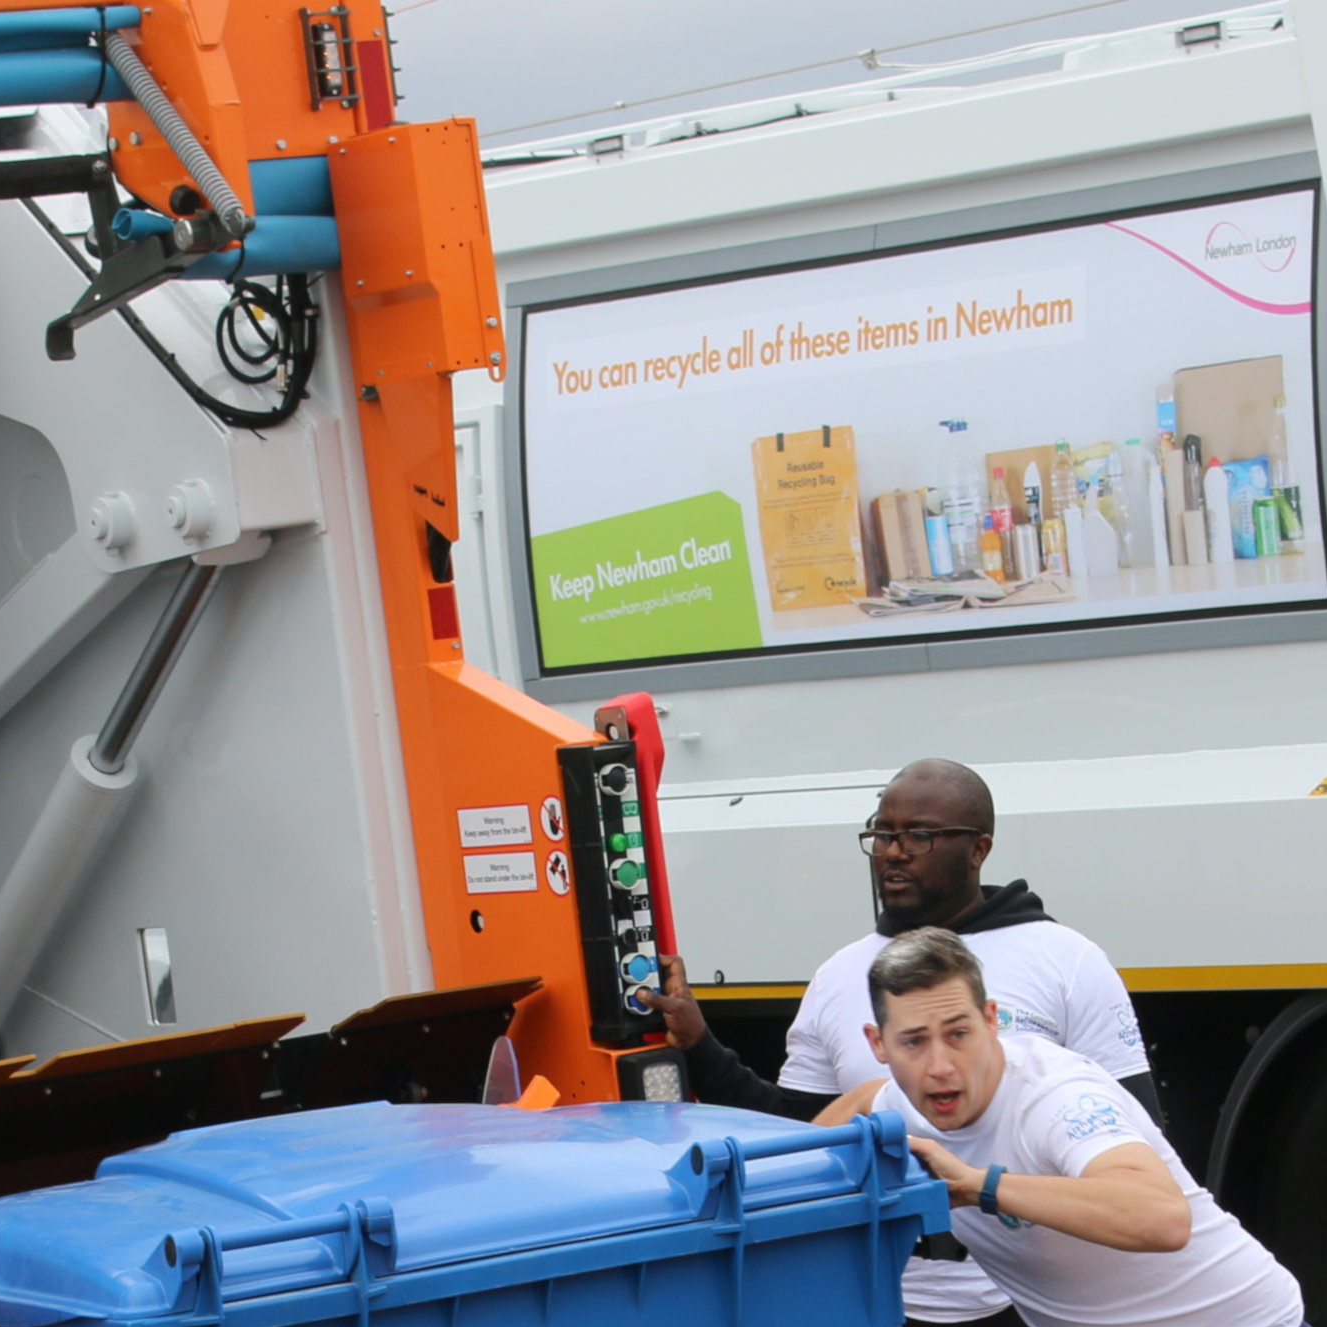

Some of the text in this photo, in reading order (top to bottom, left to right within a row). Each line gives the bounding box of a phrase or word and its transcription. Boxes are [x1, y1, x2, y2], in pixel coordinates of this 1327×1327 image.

[1204, 234, 1297, 260] Newham London
[552, 288, 1073, 395] You can recycle all of these items in Newham
[777, 473, 836, 490] Recycling Bag
[786, 460, 825, 473] Reusable
[549, 537, 733, 603] Keep Newham Clean
[578, 583, 713, 625] www.newham.gov.uk/recycling
